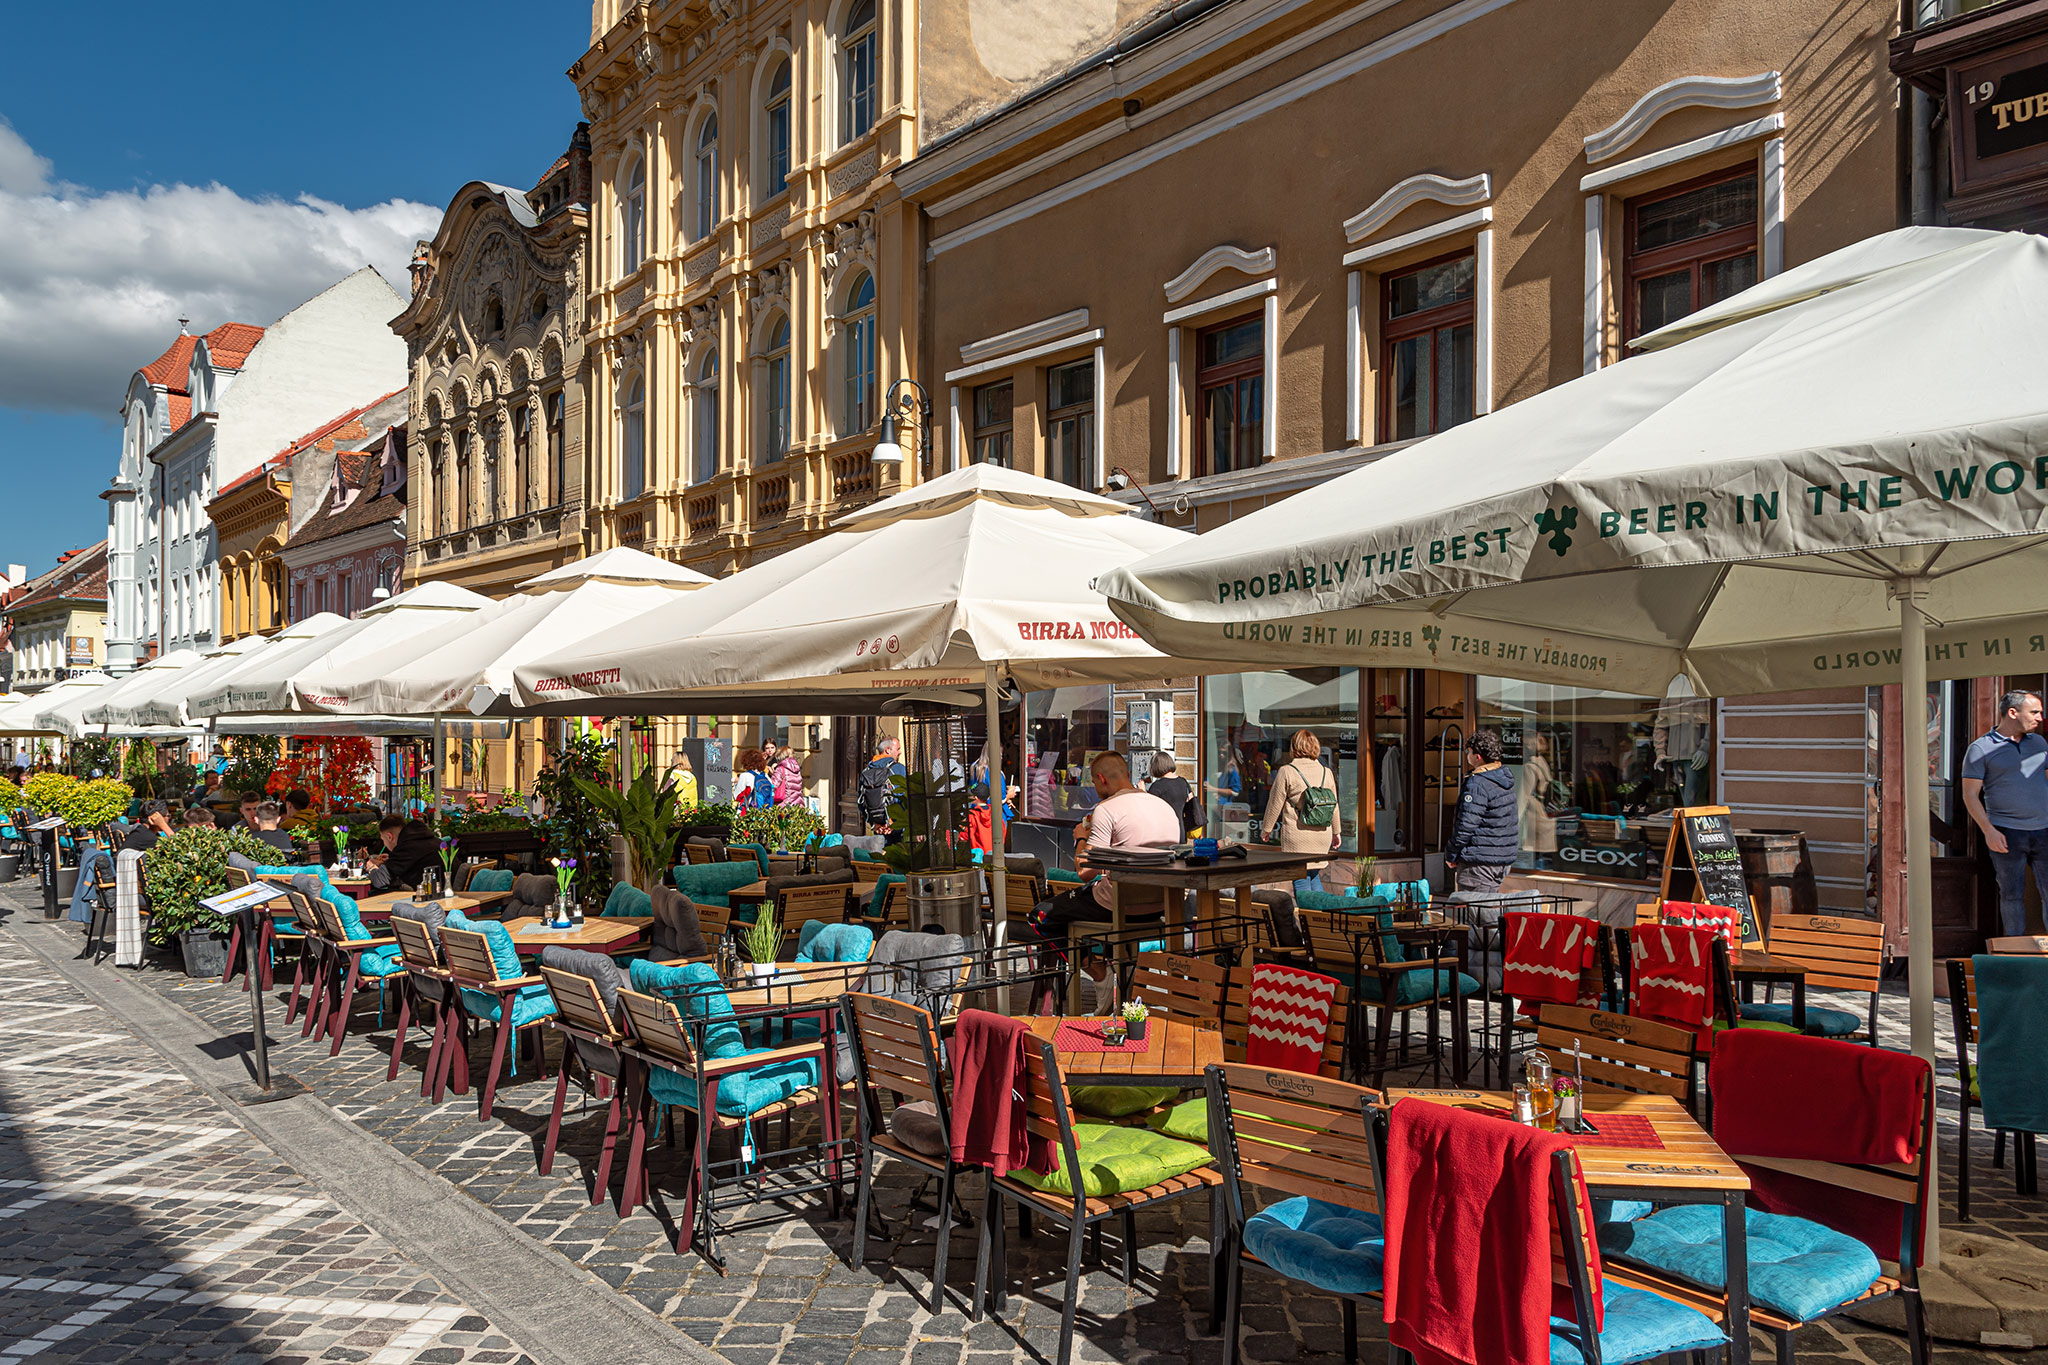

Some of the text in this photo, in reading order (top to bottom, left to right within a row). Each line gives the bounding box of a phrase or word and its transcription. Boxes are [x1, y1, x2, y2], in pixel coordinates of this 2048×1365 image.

[1964, 81, 1995, 105] 19
[1600, 501, 1708, 539] BEER
[1735, 490, 1779, 525] IN
[1806, 476, 1903, 515] THE
[1218, 527, 1512, 604] PROBABLY THE BEST
[1018, 622, 1086, 641] BIRRA
[534, 668, 621, 692] BIRRA MORETTI
[1559, 847, 1638, 867] GEOX
[1810, 918, 1840, 930] Carlsberg
[872, 1000, 896, 1018] Carlsberg
[1590, 1013, 1632, 1036] Carlsberg
[1266, 1072, 1314, 1097] Carlsberg
[1626, 1164, 1719, 1175] Carlsberg
